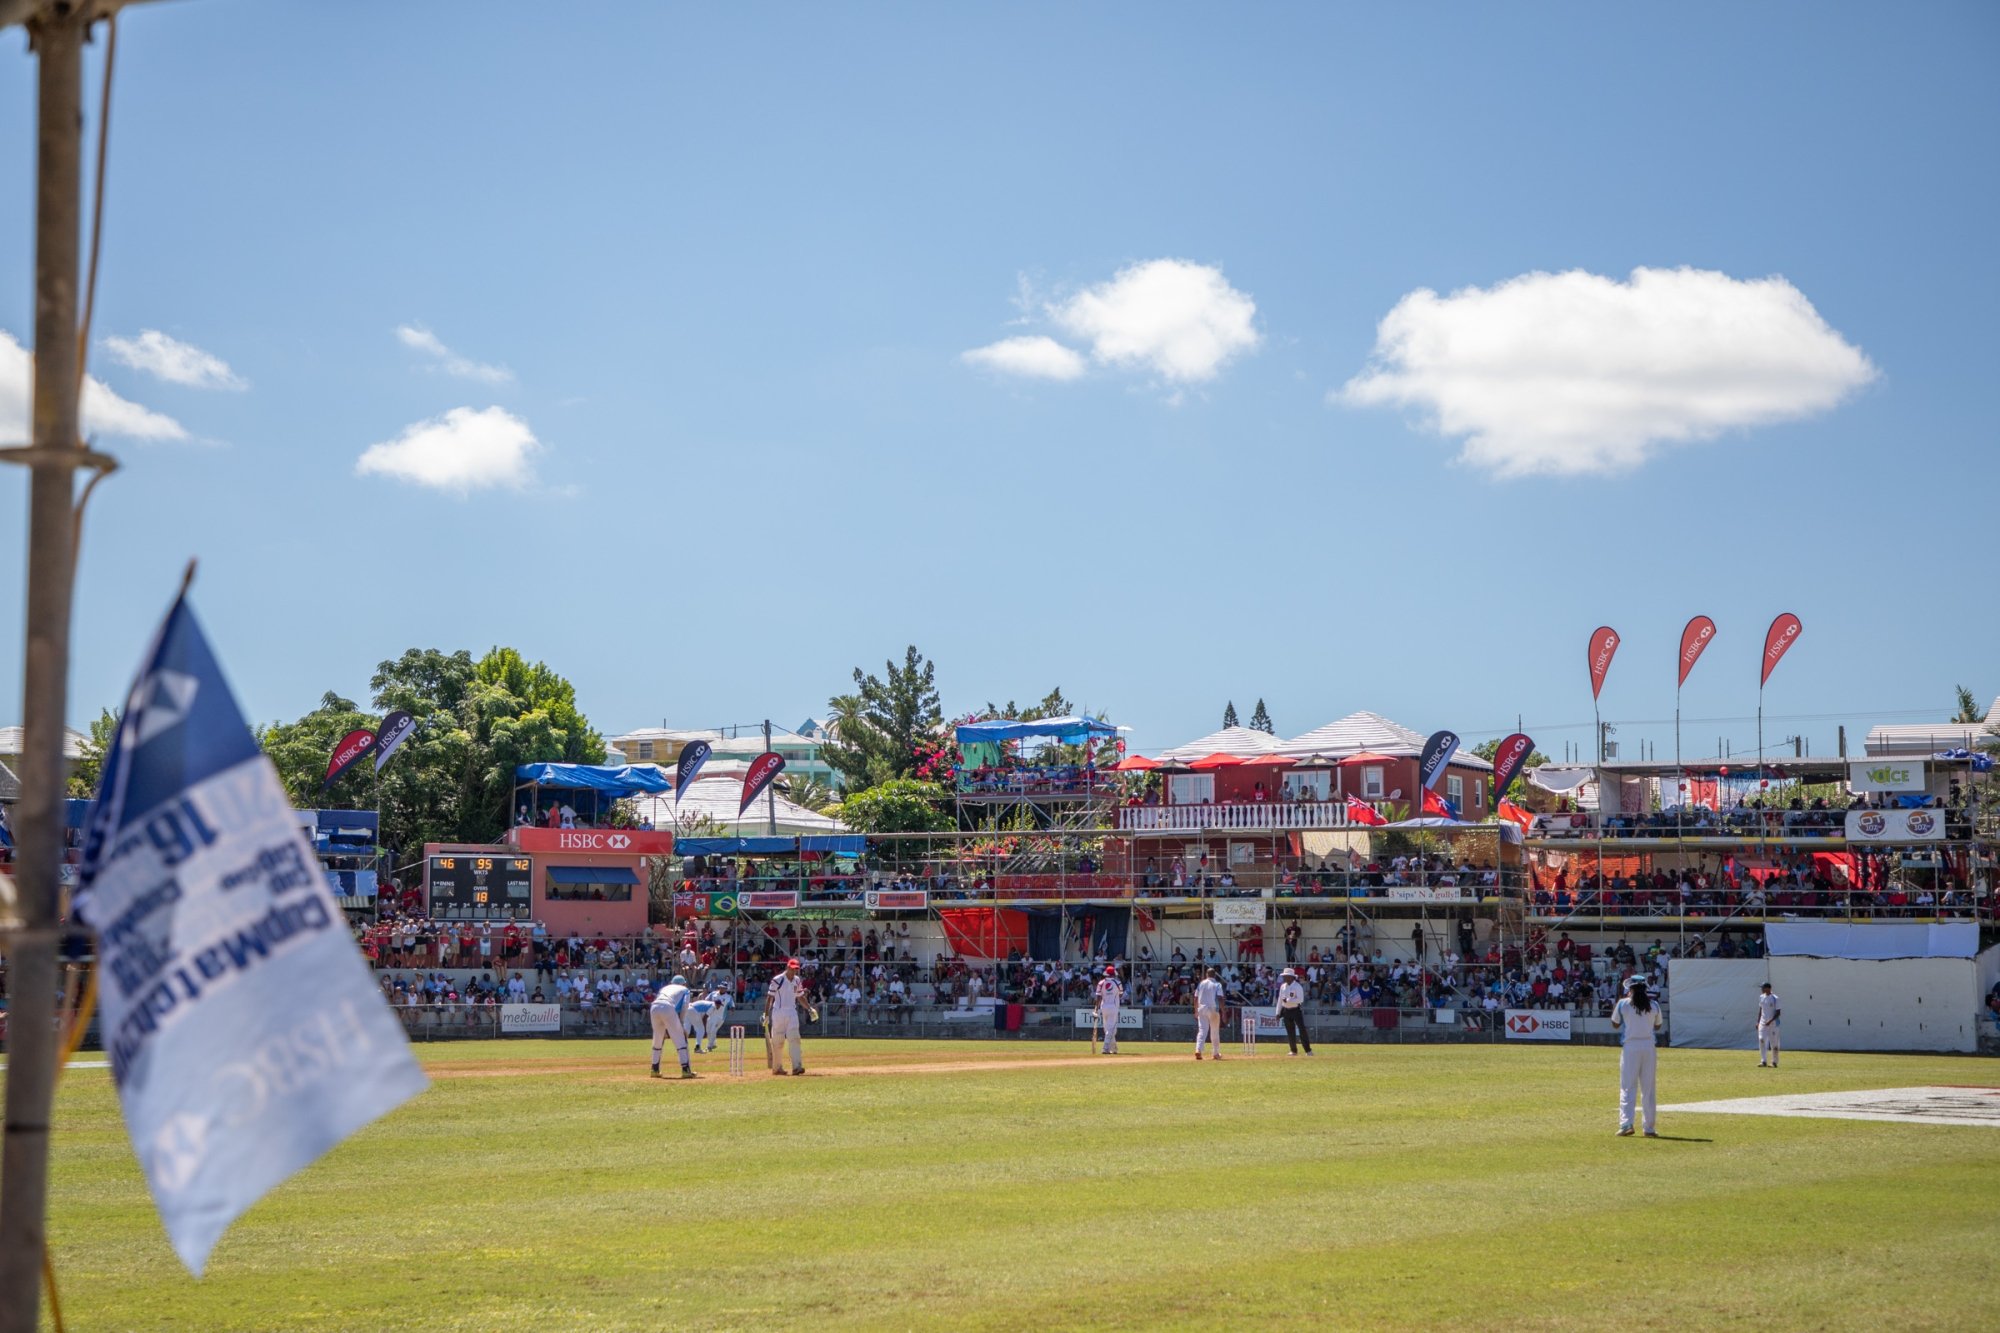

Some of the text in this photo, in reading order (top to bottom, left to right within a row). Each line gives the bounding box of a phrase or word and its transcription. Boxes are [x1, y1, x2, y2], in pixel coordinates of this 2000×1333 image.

[1684, 637, 1704, 663] HSBC
[1768, 634, 1789, 659] HSBC
[1594, 648, 1609, 676] HSBC
[379, 726, 400, 750] HSBC
[335, 744, 360, 767] HSBC
[680, 755, 699, 778] HSBC
[1424, 747, 1445, 774] HSBC
[1497, 752, 1519, 777] HSBC
[748, 766, 770, 789] HSBC
[560, 833, 604, 849] HSBC
[440, 858, 529, 870] 46 95 42
[477, 892, 488, 902] 18
[502, 1007, 559, 1024] mediaville
[1542, 1020, 1569, 1029] HSBC
[213, 998, 374, 1128] HSBC
